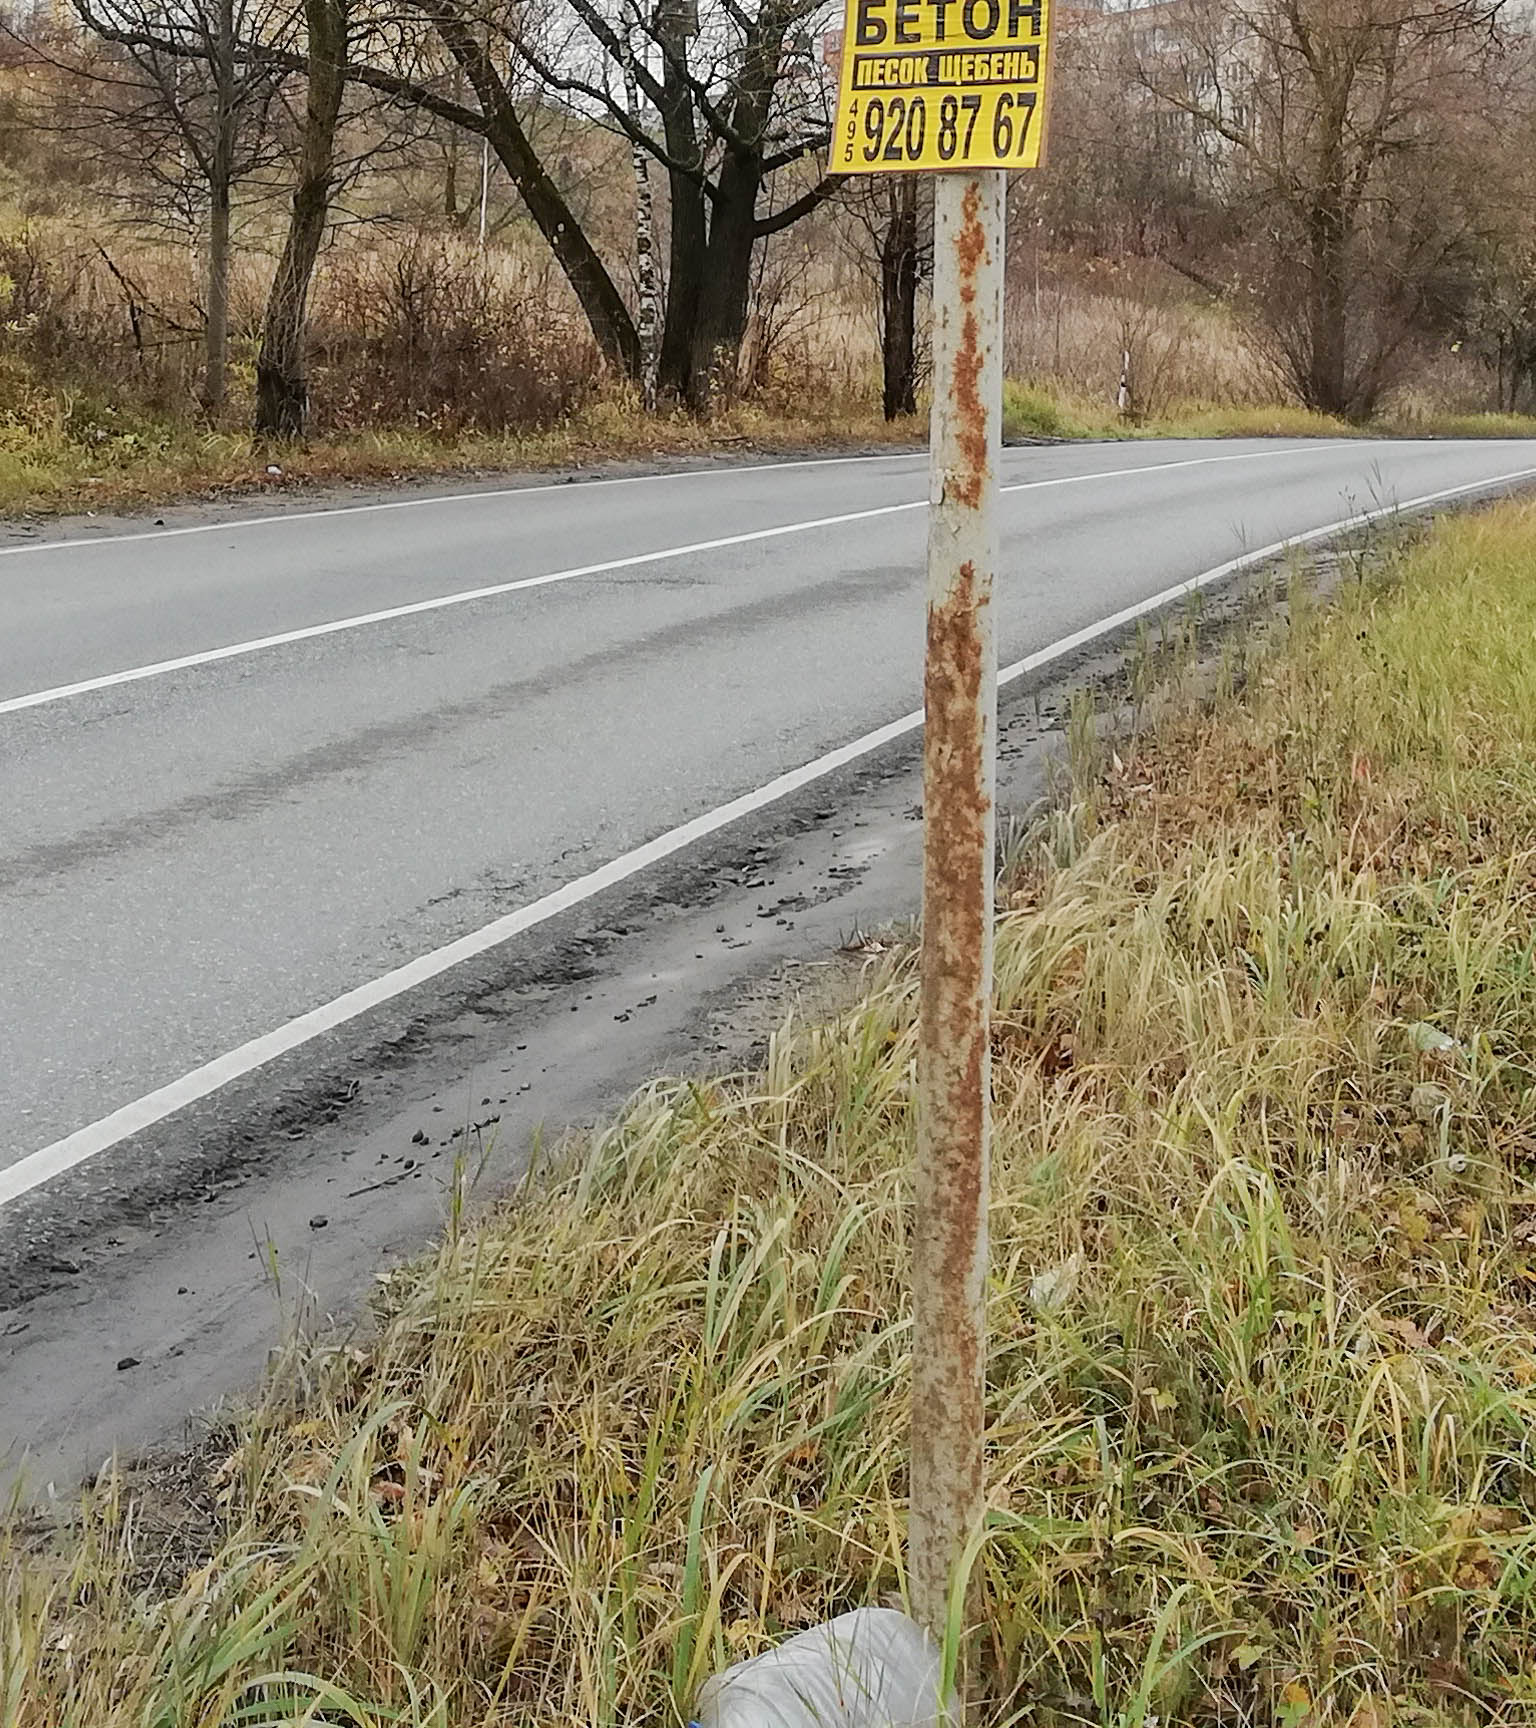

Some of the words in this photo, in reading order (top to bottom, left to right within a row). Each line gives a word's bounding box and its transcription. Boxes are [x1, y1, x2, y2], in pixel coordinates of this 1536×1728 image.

[856, 57, 929, 86] ПЕСОК
[938, 52, 1035, 85] ЩЕБЕНЬ
[862, 96, 926, 161] 920
[938, 95, 982, 160] 87
[993, 92, 1037, 159] 67
